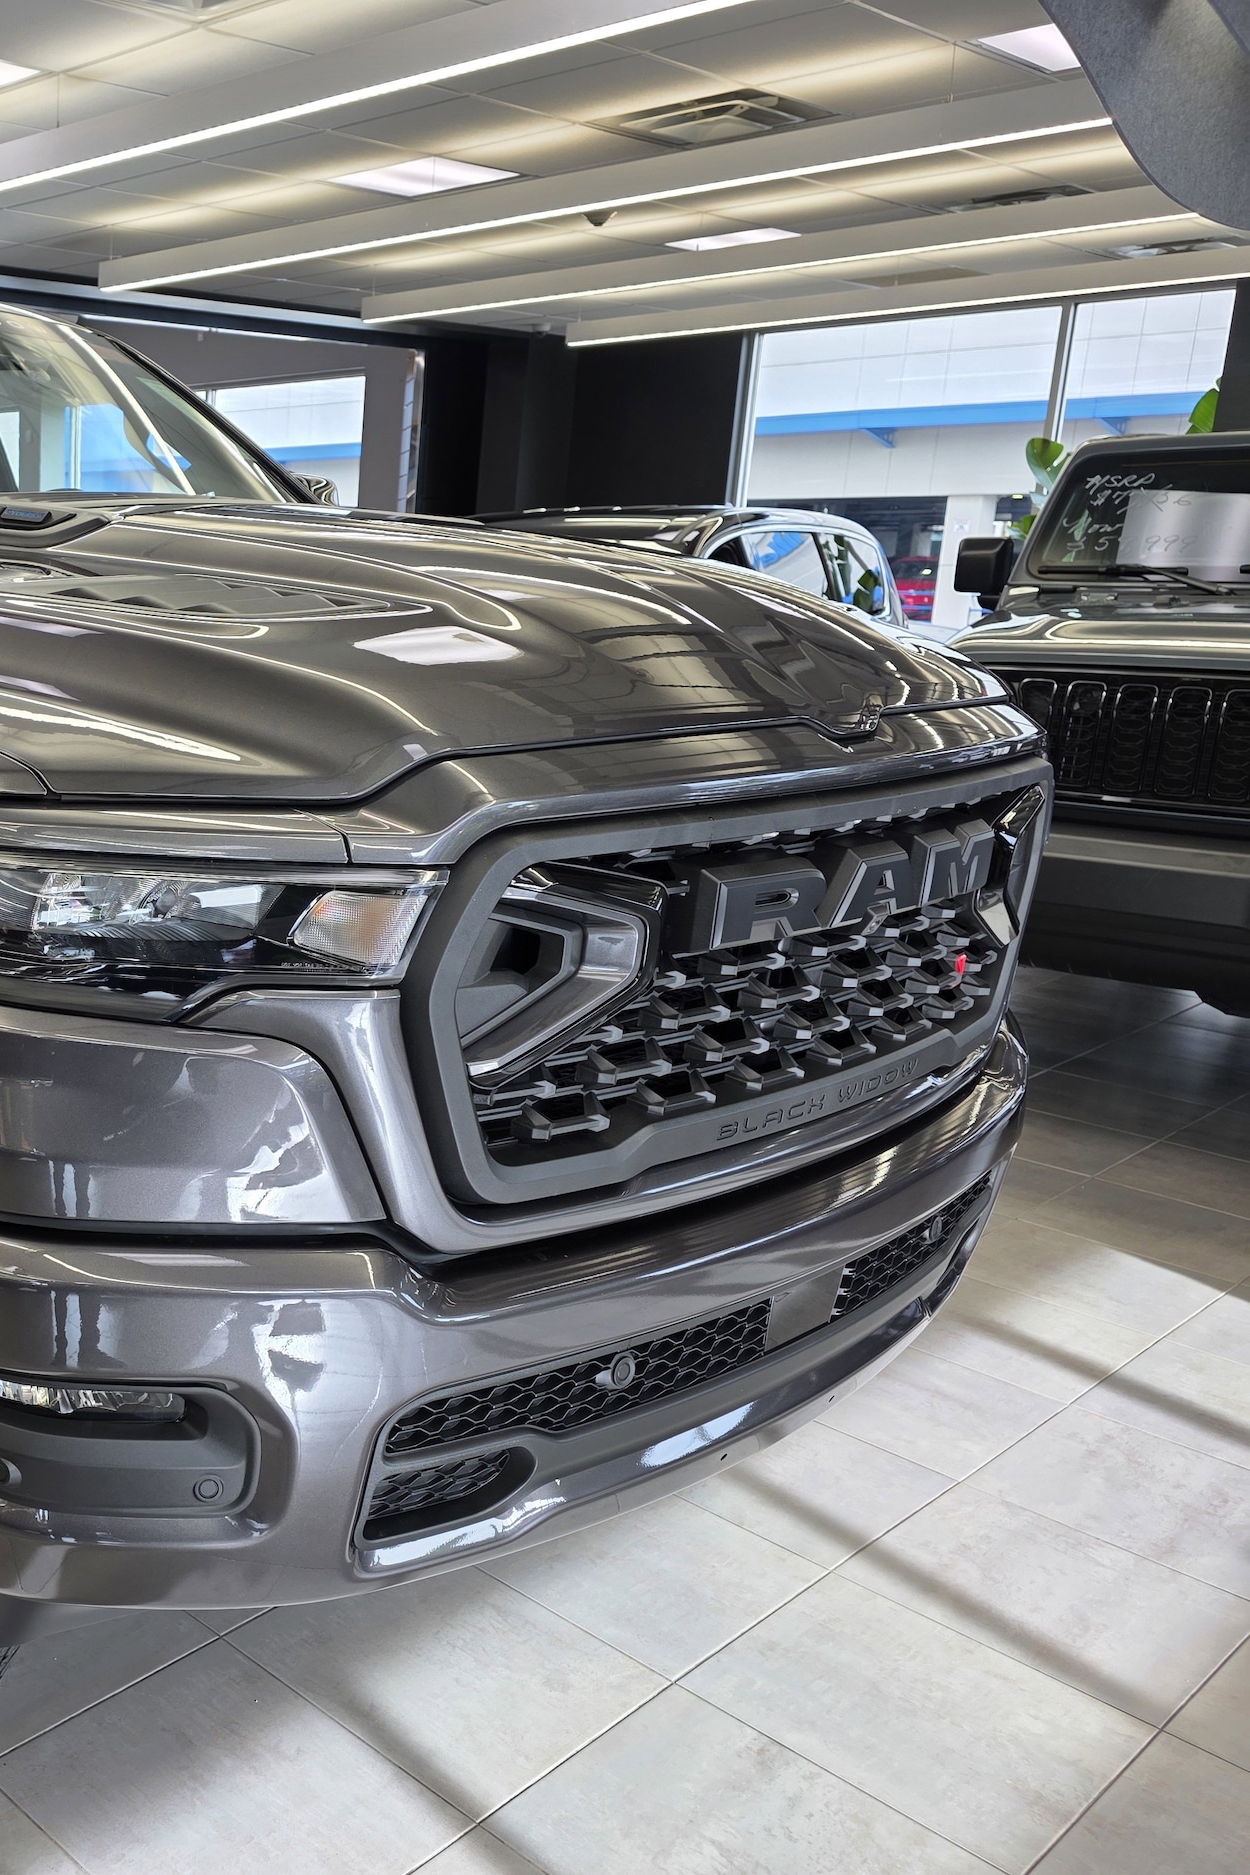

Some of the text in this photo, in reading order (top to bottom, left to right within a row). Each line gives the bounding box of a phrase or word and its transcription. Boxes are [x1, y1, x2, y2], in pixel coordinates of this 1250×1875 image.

[1085, 472, 1156, 495] MSRP
[702, 819, 995, 950] RAM
[716, 1057, 920, 1142] BLACK WIDOW
